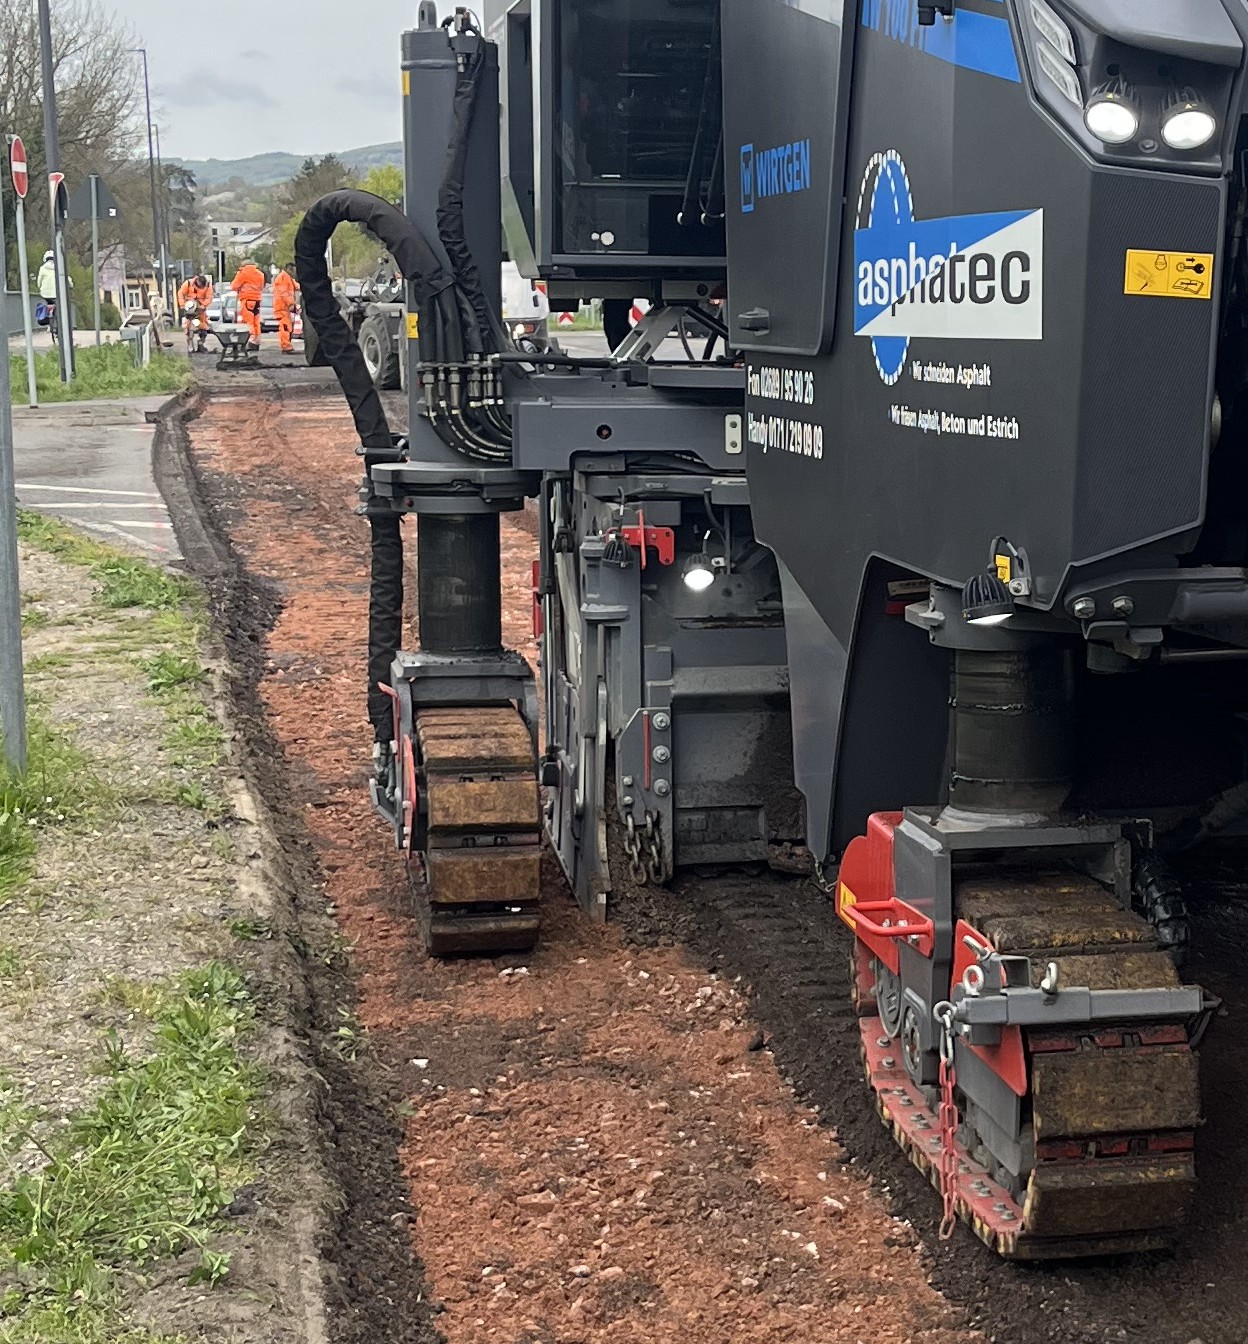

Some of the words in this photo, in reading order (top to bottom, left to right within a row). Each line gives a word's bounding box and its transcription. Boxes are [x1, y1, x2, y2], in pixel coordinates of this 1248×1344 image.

[755, 138, 810, 198] WIRTGEN
[858, 242, 1031, 317] asphatec
[747, 365, 760, 396] Fon
[784, 369, 794, 402] 95
[794, 370, 803, 403] 90
[804, 371, 814, 405] 26
[912, 361, 922, 381] Wir
[923, 362, 955, 384] schneiden
[956, 363, 991, 389] Asphalt
[747, 412, 768, 453] Handy
[769, 416, 784, 450] 0171
[789, 420, 802, 454] 219
[803, 423, 813, 457] 09
[813, 425, 823, 459] 09
[891, 404, 900, 425] Wir
[917, 409, 940, 436] Asphalt,
[941, 411, 965, 434] Beton
[967, 415, 985, 436] und
[987, 416, 1019, 440] Estrich
